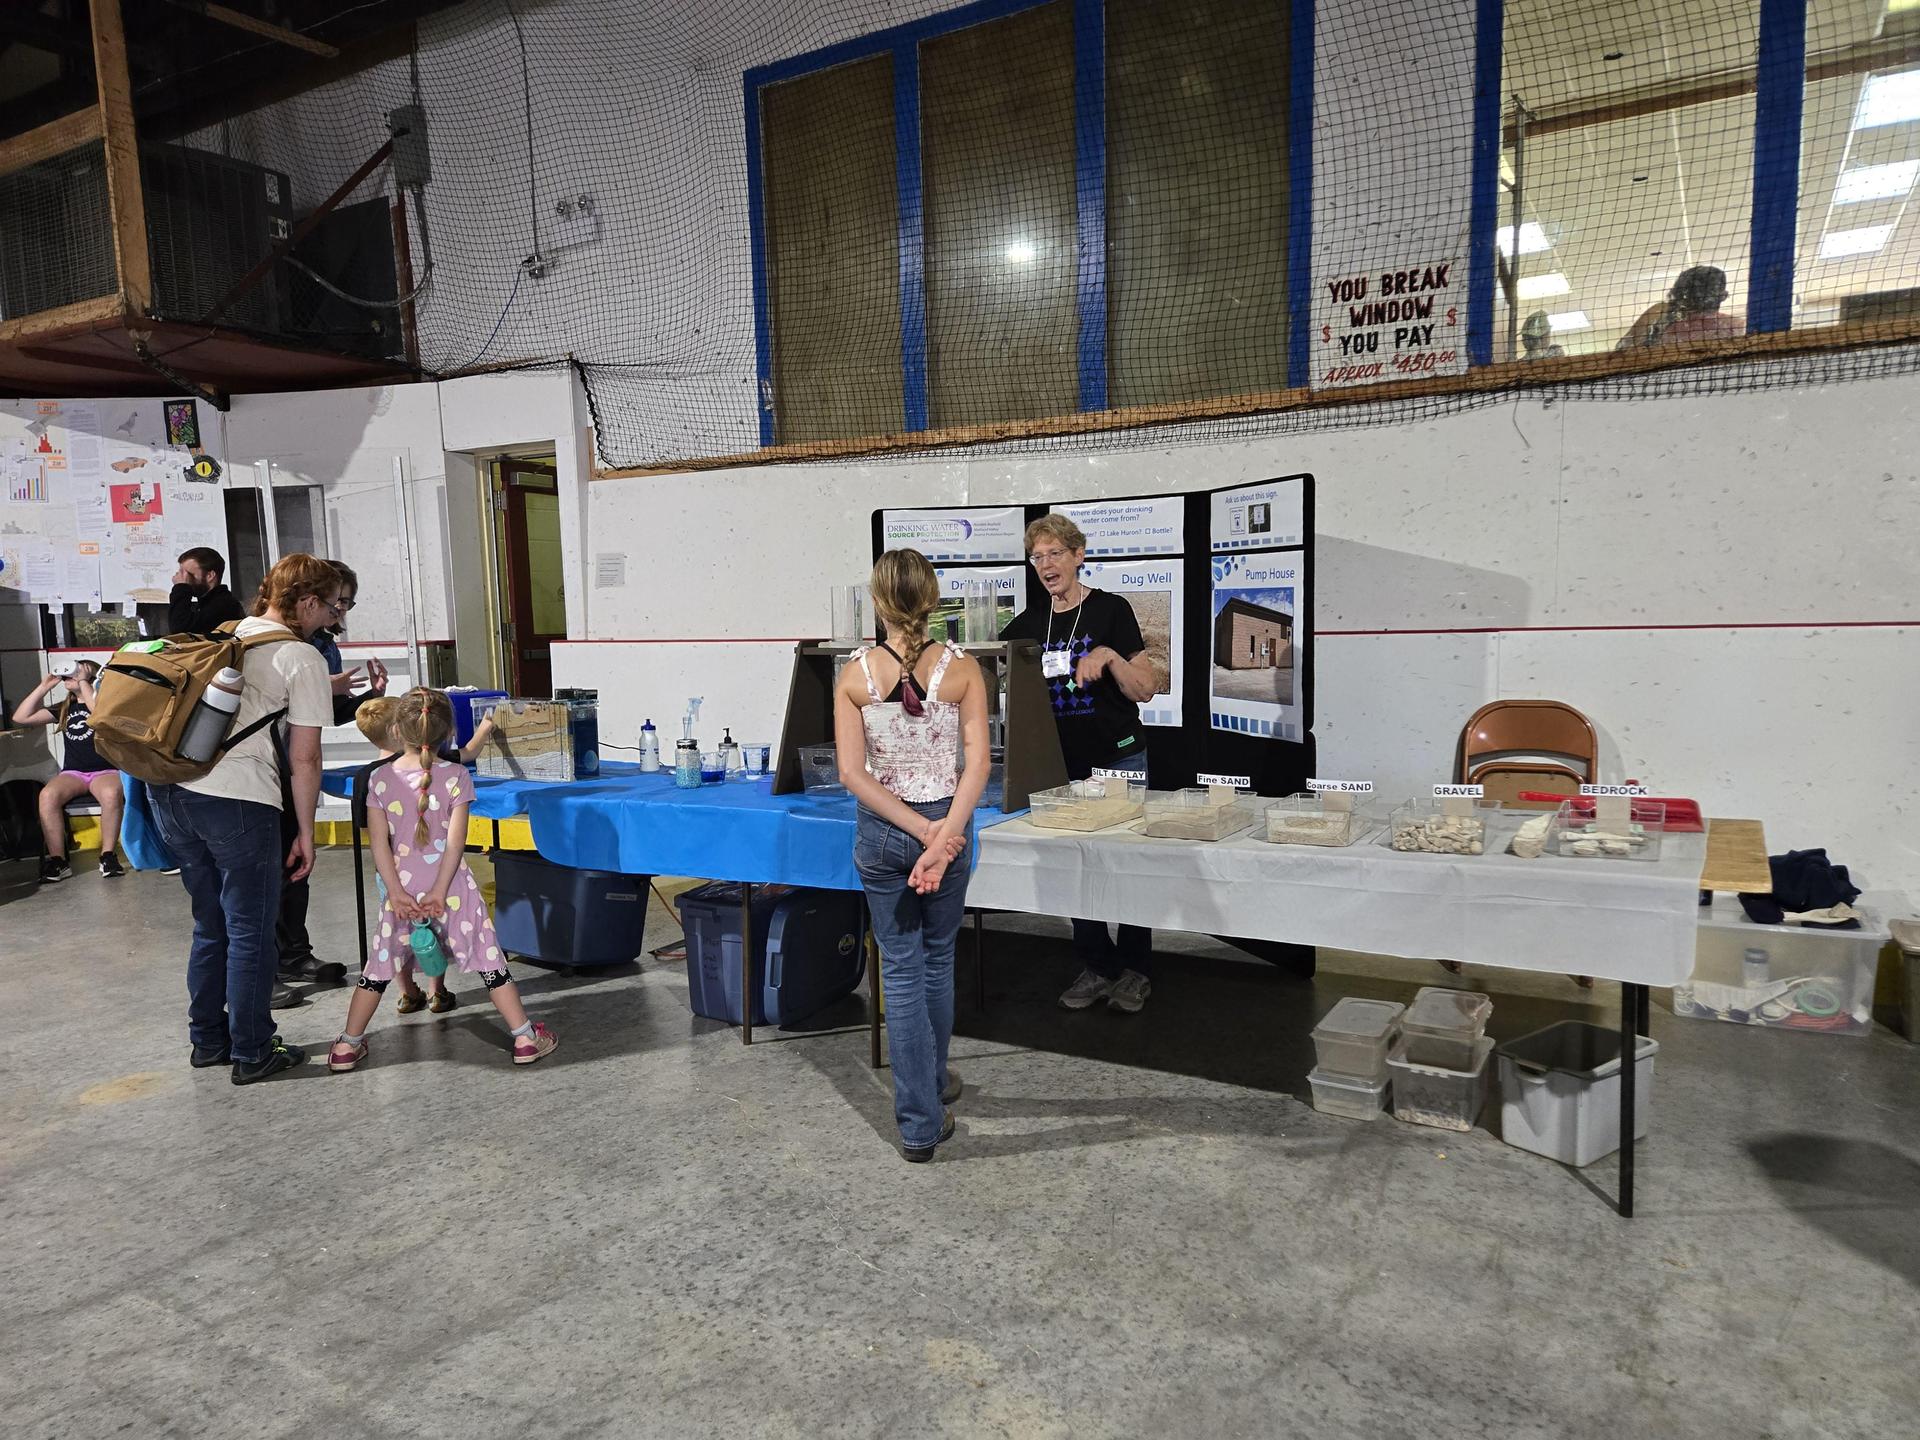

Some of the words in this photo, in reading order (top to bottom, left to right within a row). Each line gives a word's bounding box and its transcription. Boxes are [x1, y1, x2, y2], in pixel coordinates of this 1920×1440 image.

[1328, 277, 1367, 304] YOU
[1381, 264, 1449, 297] BREAK
[1349, 295, 1434, 328] WINDOW
[1446, 307, 1457, 327] $
[1322, 324, 1331, 344] $
[1339, 330, 1379, 356] YOU
[1394, 323, 1435, 349] PAY
[1321, 362, 1384, 384] APPROX
[1240, 493, 1255, 502] about
[1255, 492, 1265, 500] this
[1108, 508, 1123, 517] your
[1124, 506, 1153, 514] drinking
[1120, 514, 1140, 522] from?
[887, 524, 929, 533] DRINKING
[930, 523, 959, 531] WATER
[1120, 528, 1142, 536] Huron?
[1151, 527, 1173, 535] Bottle?
[1121, 573, 1144, 586] Dug
[1147, 572, 1172, 584] Well
[1245, 568, 1268, 583] Pump
[1269, 567, 1295, 580] House
[1091, 768, 1109, 777] SILT
[1111, 770, 1118, 778] &
[1120, 771, 1145, 779] CLAY
[1198, 775, 1218, 784] Fine
[1220, 776, 1249, 786] SAND
[1306, 781, 1338, 790] Coarse
[1340, 782, 1372, 791] SAND
[1433, 786, 1483, 796] GRAVEL
[1582, 785, 1648, 795] BEDROCK
